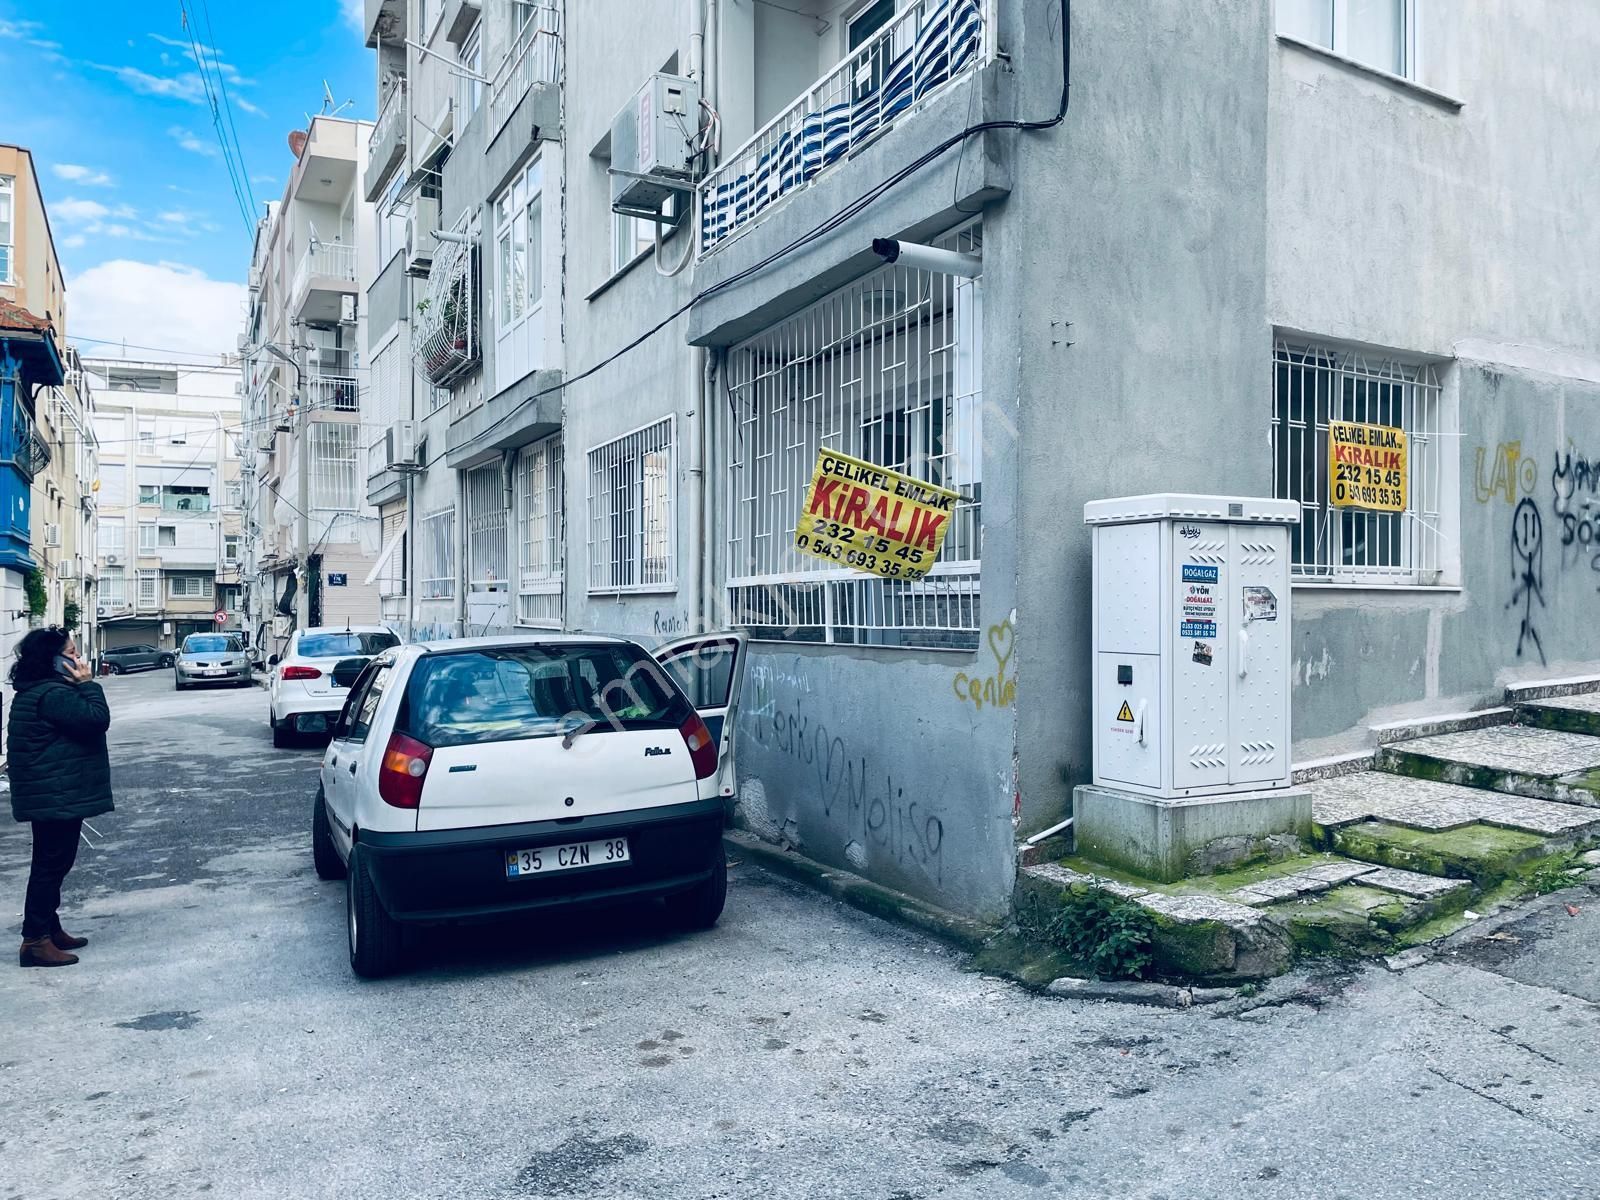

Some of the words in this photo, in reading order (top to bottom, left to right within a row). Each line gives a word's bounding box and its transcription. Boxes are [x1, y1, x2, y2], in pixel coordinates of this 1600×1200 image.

[1369, 430, 1396, 448] EMLAK
[1336, 464, 1361, 483] 232
[1366, 468, 1380, 485] 15
[1385, 471, 1401, 487] 45
[894, 480, 953, 511] EMLAK
[1336, 483, 1345, 500] 0
[1361, 486, 1377, 504] 693
[1379, 488, 1389, 505] 35
[1391, 489, 1402, 506] 35
[813, 519, 856, 544] 232
[863, 534, 891, 553] 15
[895, 546, 924, 564] 45
[797, 535, 809, 549] 0
[812, 538, 843, 560] 543
[846, 549, 877, 570] 693
[880, 559, 902, 576] 35
[903, 567, 924, 580] 35
[1196, 585, 1210, 595] YÖN
[522, 851, 542, 871] 35
[558, 845, 590, 867] CZN
[605, 839, 625, 860] 38
